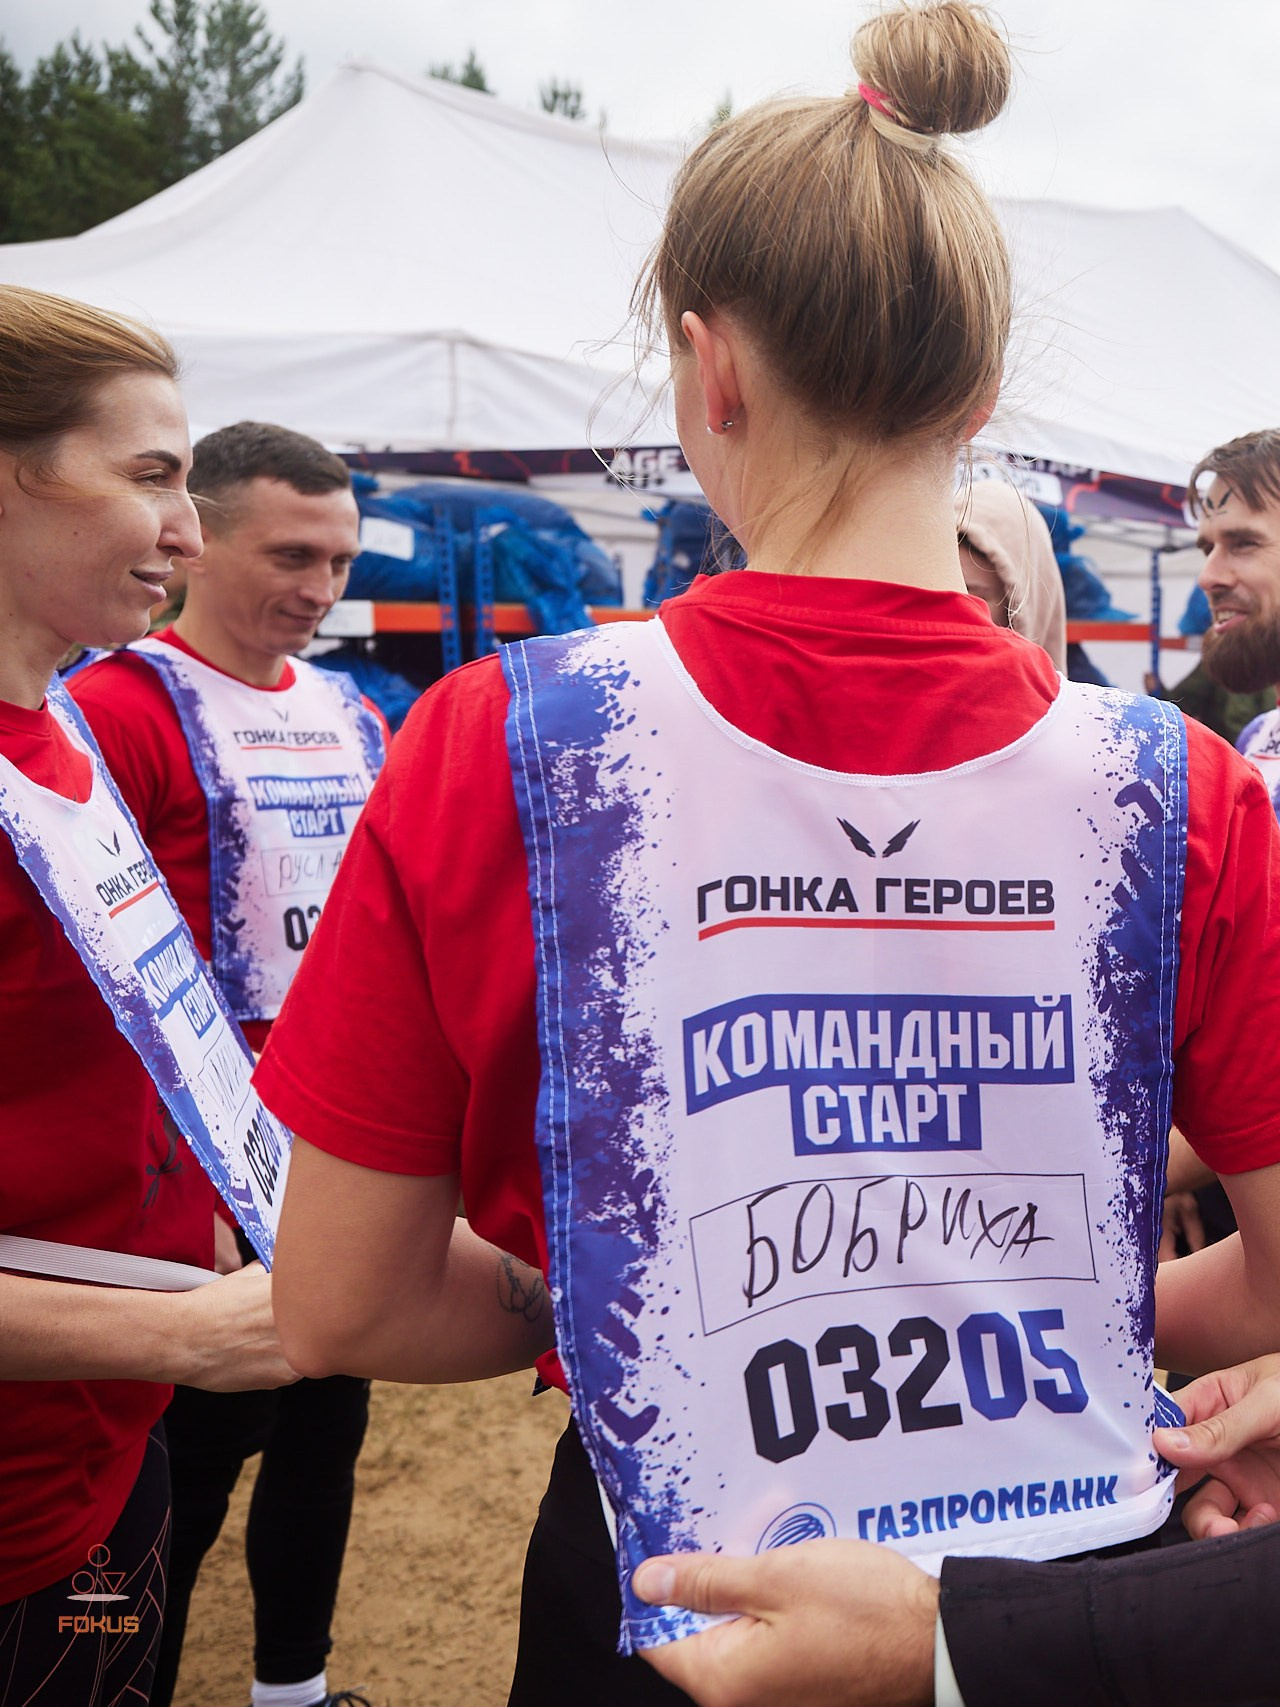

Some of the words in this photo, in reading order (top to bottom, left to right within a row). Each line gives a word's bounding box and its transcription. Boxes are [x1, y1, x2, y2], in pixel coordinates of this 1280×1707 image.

[289, 808, 340, 836] СТАРТ
[279, 850, 343, 889] РУСЛА
[697, 874, 859, 924] ГОНКА
[875, 876, 1056, 916] ГЕРОЕВ
[692, 994, 1067, 1097] КОМАНДНЫЙ
[802, 1082, 969, 1147] СТАРТ
[742, 1177, 1056, 1308] БОБРИХА
[743, 1307, 1090, 1464] 03205
[857, 1474, 1119, 1543] ГАЗПРОМБАНК
